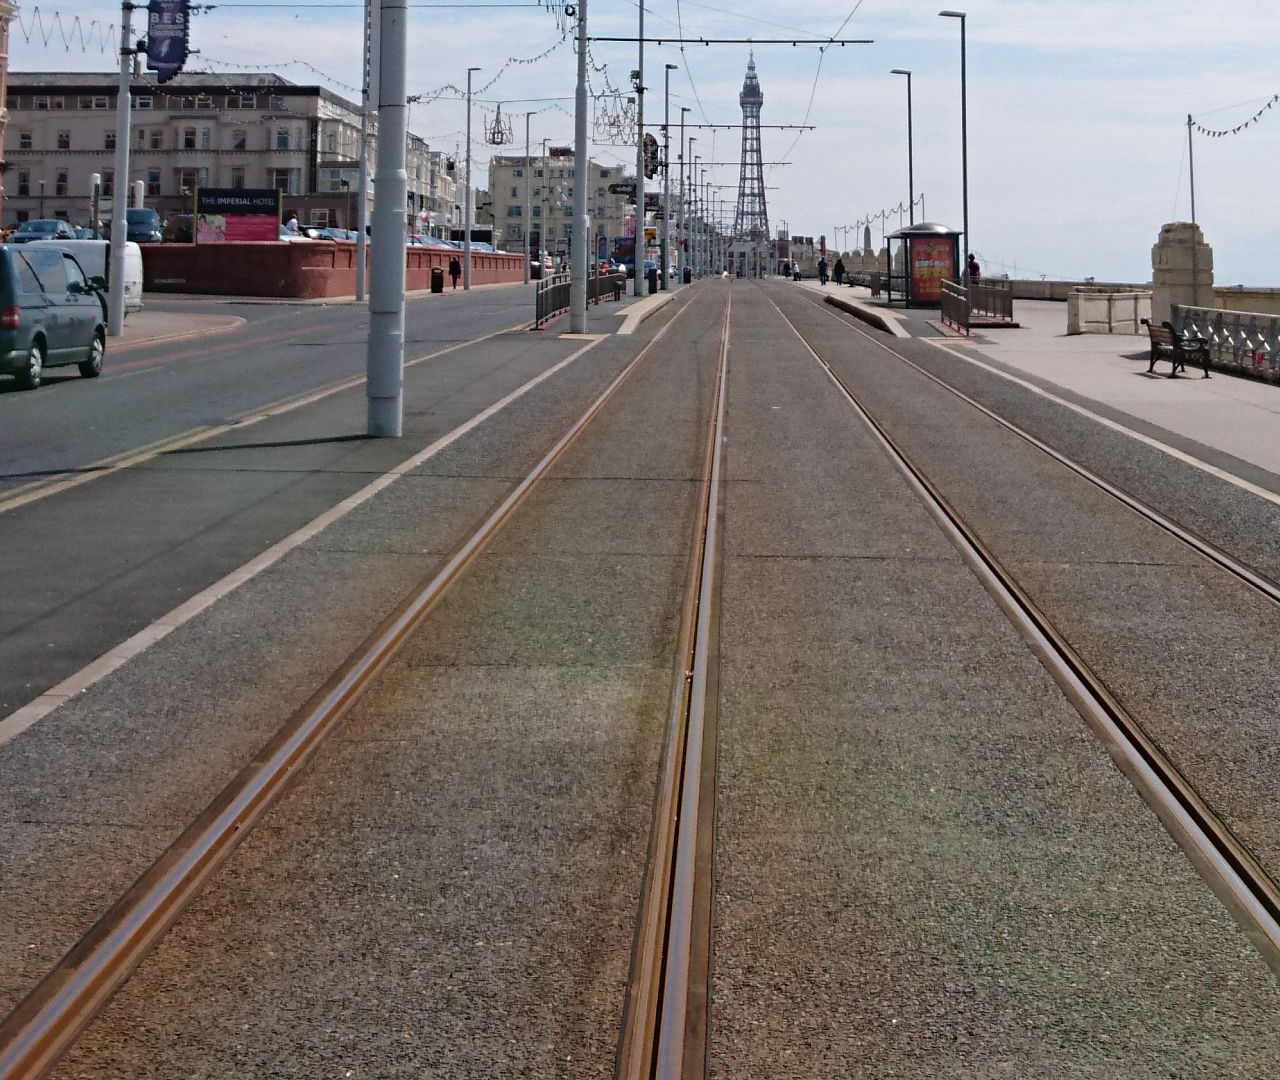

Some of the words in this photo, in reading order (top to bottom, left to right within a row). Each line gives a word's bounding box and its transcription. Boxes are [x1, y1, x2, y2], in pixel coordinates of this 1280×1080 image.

[202, 197, 216, 205] THE
[217, 197, 251, 205] IMPERIAL
[253, 198, 275, 206] HOTEL
